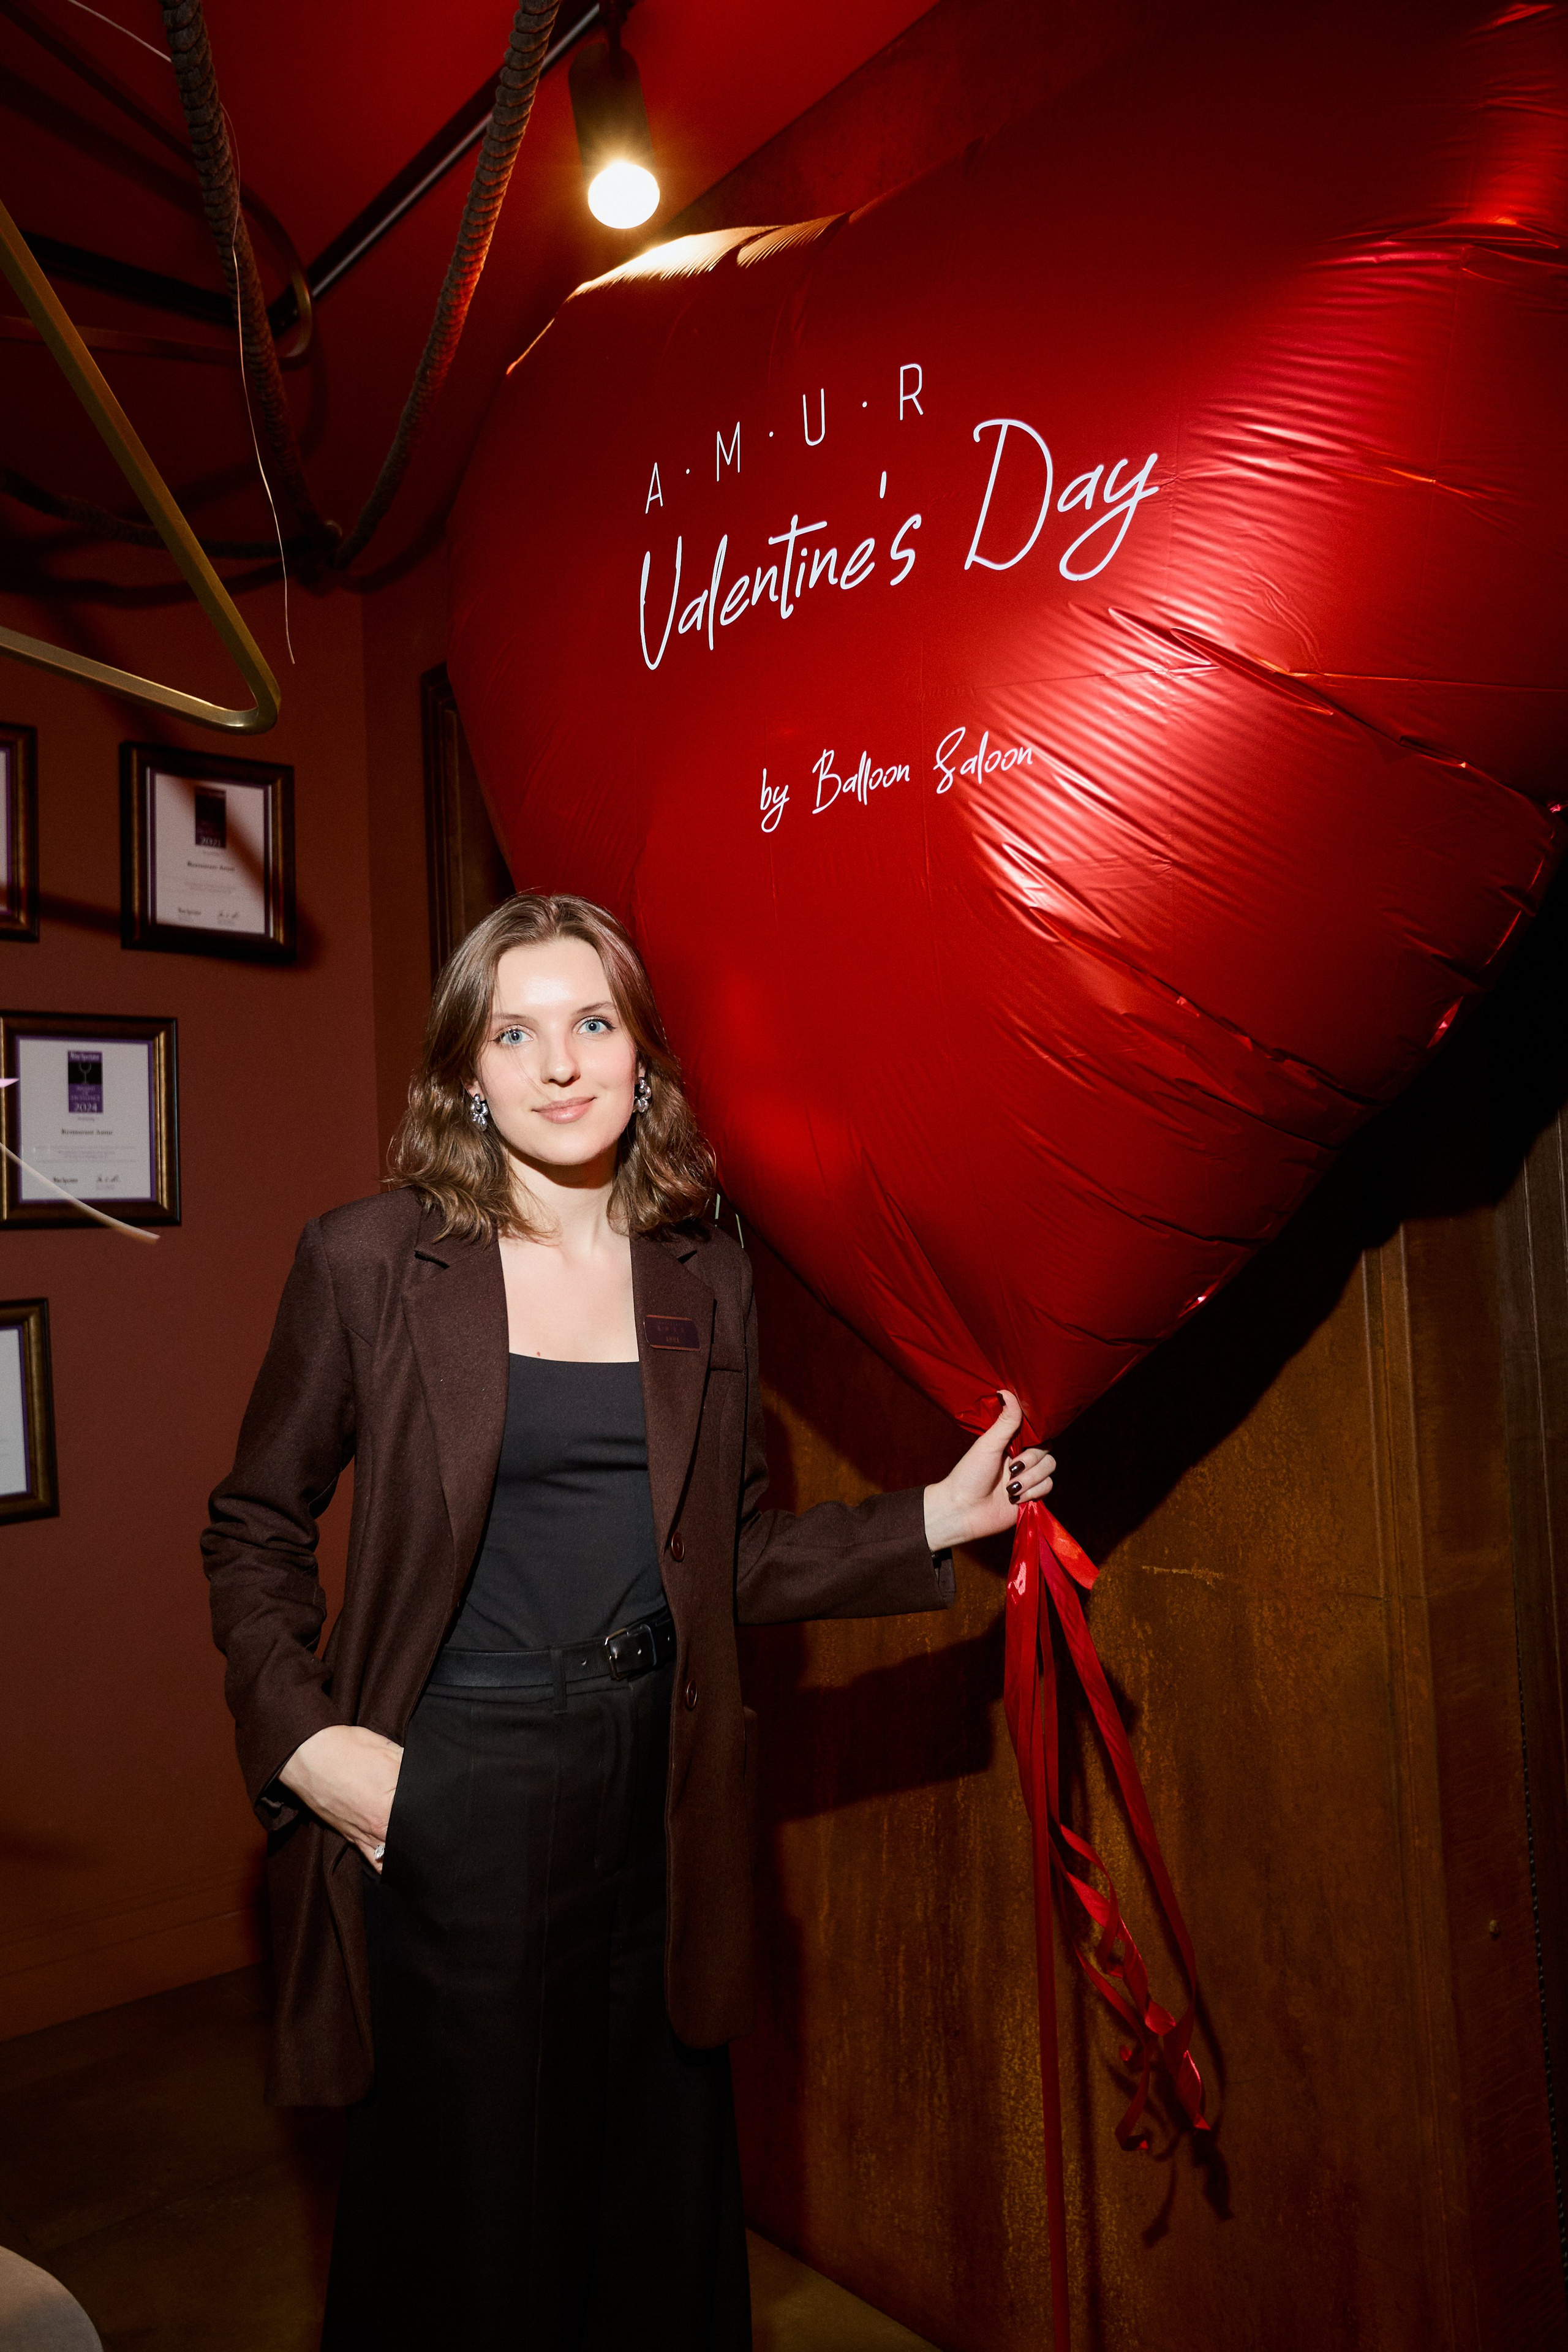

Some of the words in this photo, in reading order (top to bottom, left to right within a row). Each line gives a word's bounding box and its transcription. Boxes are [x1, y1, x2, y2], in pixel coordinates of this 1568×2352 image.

[639, 470, 922, 671] Valentine's
[964, 418, 1160, 581] Day
[760, 767, 790, 833] by
[812, 748, 910, 815] Balloon
[933, 726, 1033, 794] Saloon
